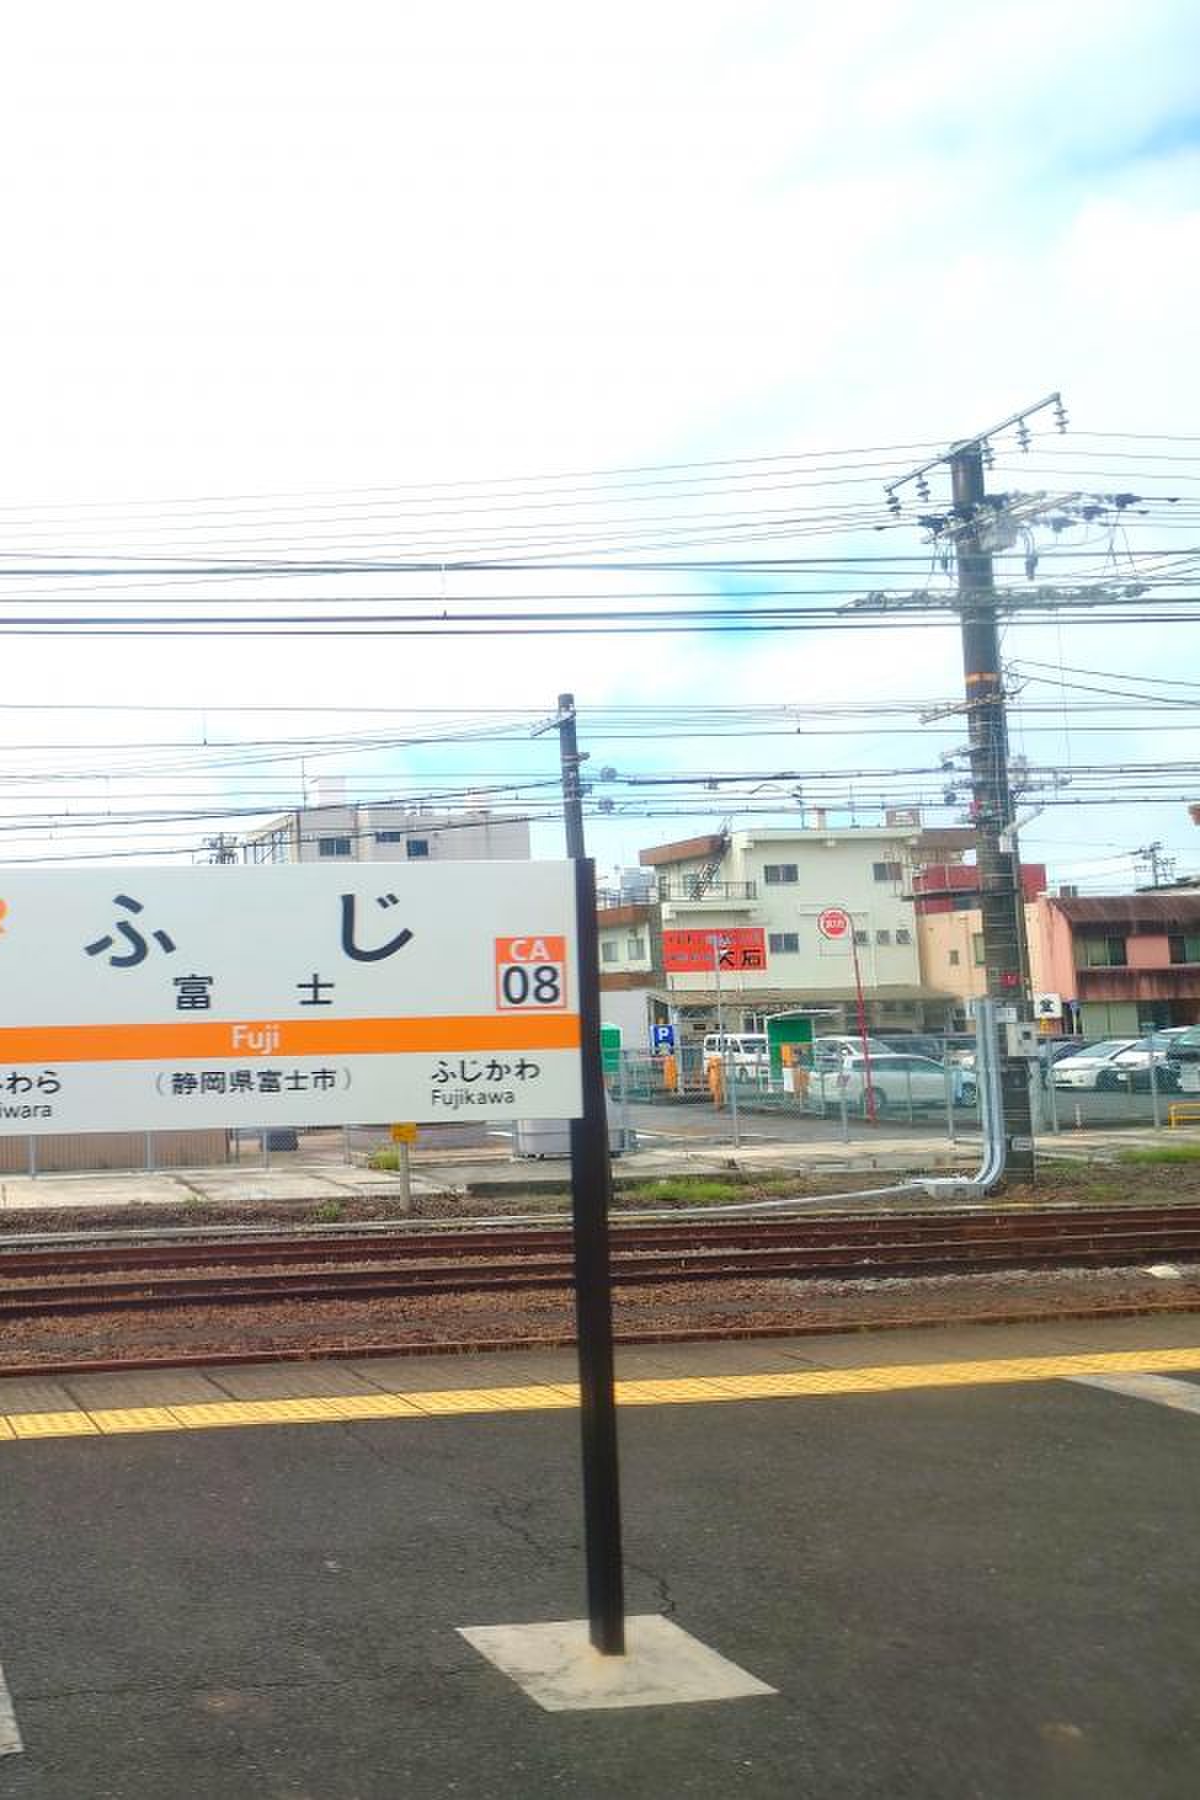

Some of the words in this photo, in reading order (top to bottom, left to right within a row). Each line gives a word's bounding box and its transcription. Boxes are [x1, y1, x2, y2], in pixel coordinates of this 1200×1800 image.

[85, 893, 414, 967] ふじ
[509, 939, 552, 961] CA
[172, 974, 335, 1010] 富士
[502, 965, 560, 1005] 08
[232, 1024, 279, 1055] Fuji
[658, 1027, 670, 1041] P
[431, 1058, 541, 1083] ふじかわ
[431, 1088, 515, 1110] Fujikawa
